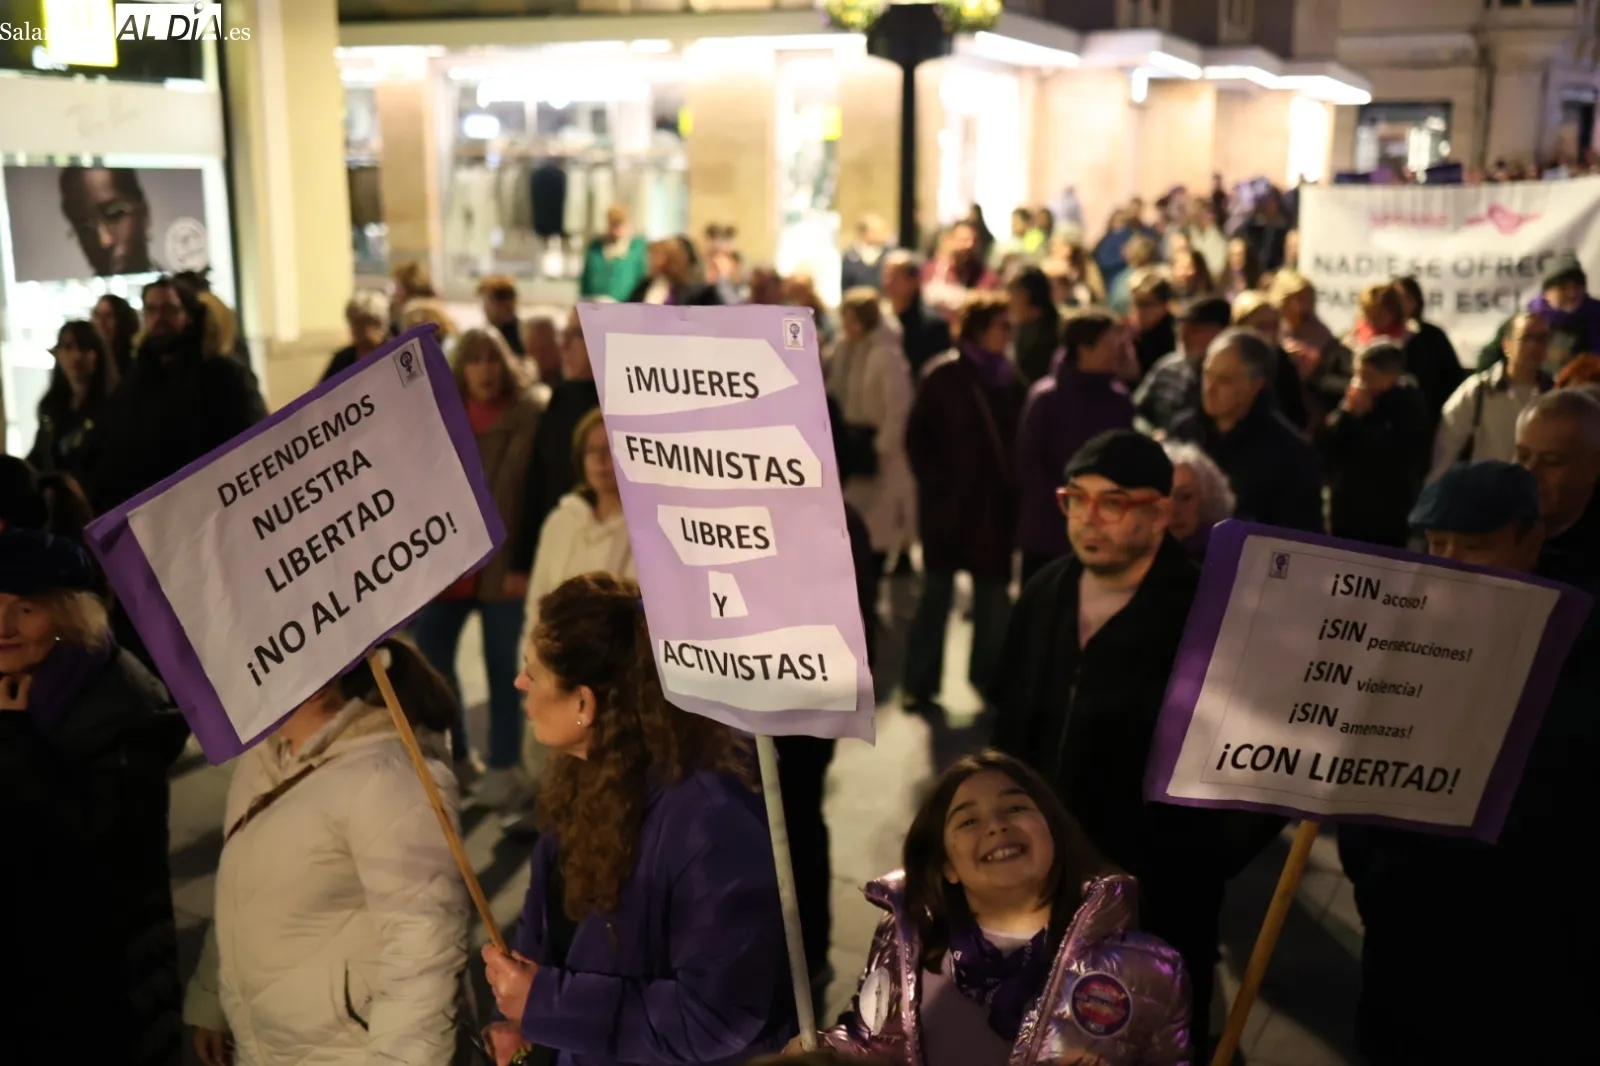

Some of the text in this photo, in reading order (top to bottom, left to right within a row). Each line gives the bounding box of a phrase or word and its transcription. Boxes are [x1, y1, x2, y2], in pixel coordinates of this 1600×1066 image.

[626, 366, 760, 399] ¡MUJERES
[217, 394, 376, 507] DEFENDEMOS
[625, 435, 806, 487] FEMINISTAS
[252, 449, 372, 540] NUESTRA
[265, 488, 395, 593] LIBERTAD
[680, 517, 770, 550] LIBRES
[247, 511, 458, 686] ¡NO AL ACOSO!
[712, 592, 728, 617] Y
[1331, 573, 1427, 610] ¡SIN acoso!
[663, 639, 829, 682] ACTIVISTAS!
[1318, 618, 1473, 662] ¡SIN persecuciones!
[1304, 660, 1423, 698] ¡SIN violencia!
[1288, 702, 1413, 739] ¡SIN amenazas!
[1216, 743, 1461, 795] ¡CON LIBERTAD!
